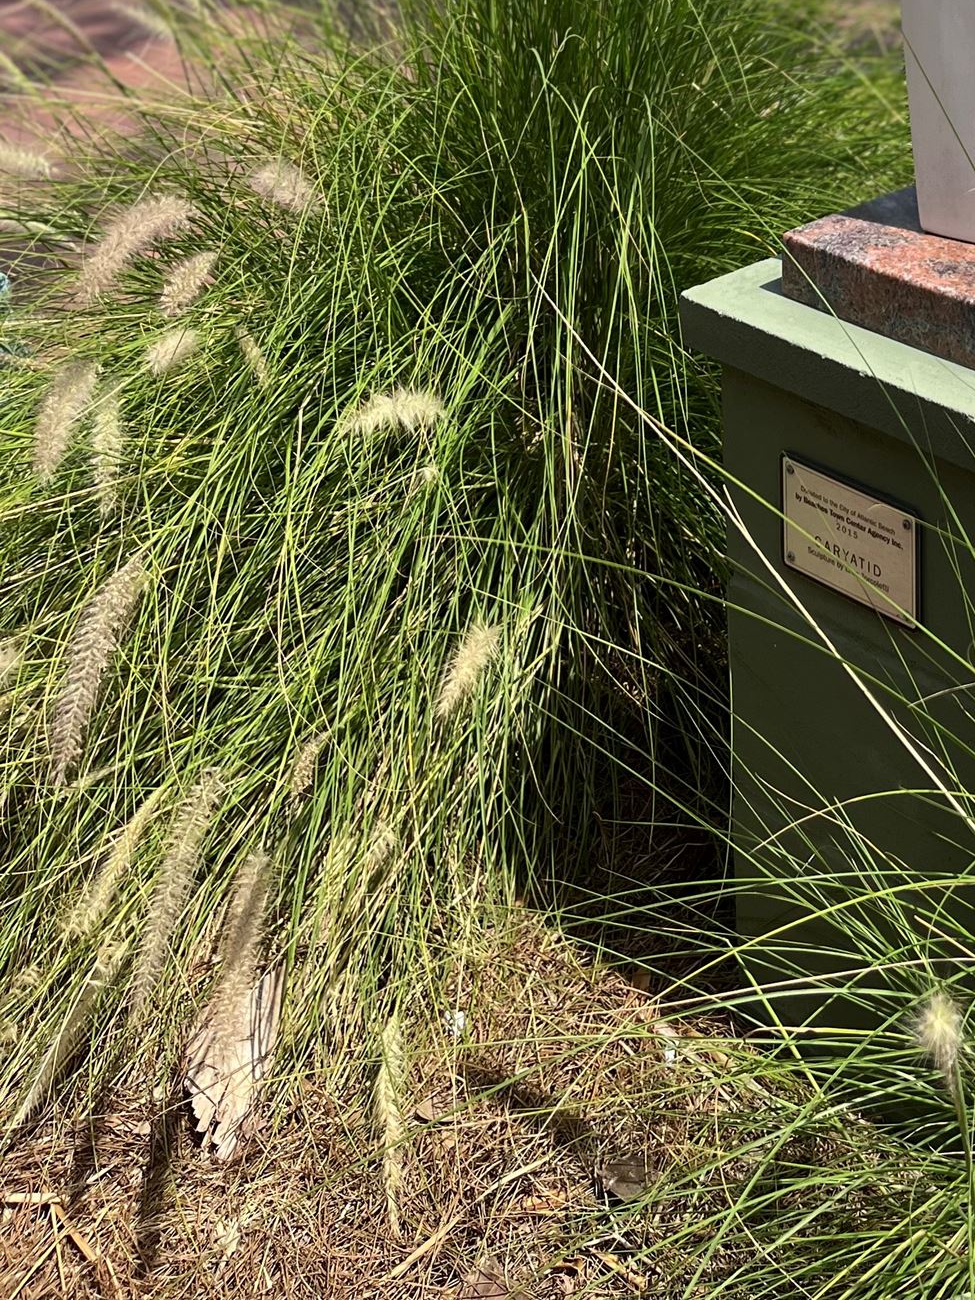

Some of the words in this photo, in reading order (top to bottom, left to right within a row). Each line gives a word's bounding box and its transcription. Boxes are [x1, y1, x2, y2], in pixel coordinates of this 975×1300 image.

[795, 492, 802, 502] by
[829, 508, 845, 523] Town
[846, 516, 866, 532] Center
[867, 527, 890, 545] Agency
[823, 496, 829, 504] to
[830, 499, 838, 509] the
[839, 504, 849, 514] City
[857, 513, 877, 527] Atlantic
[878, 522, 896, 536] Beach
[836, 522, 859, 540] 2015
[807, 546, 835, 565] Sculpture
[836, 561, 844, 571] by
[814, 535, 882, 577] CARYATID
